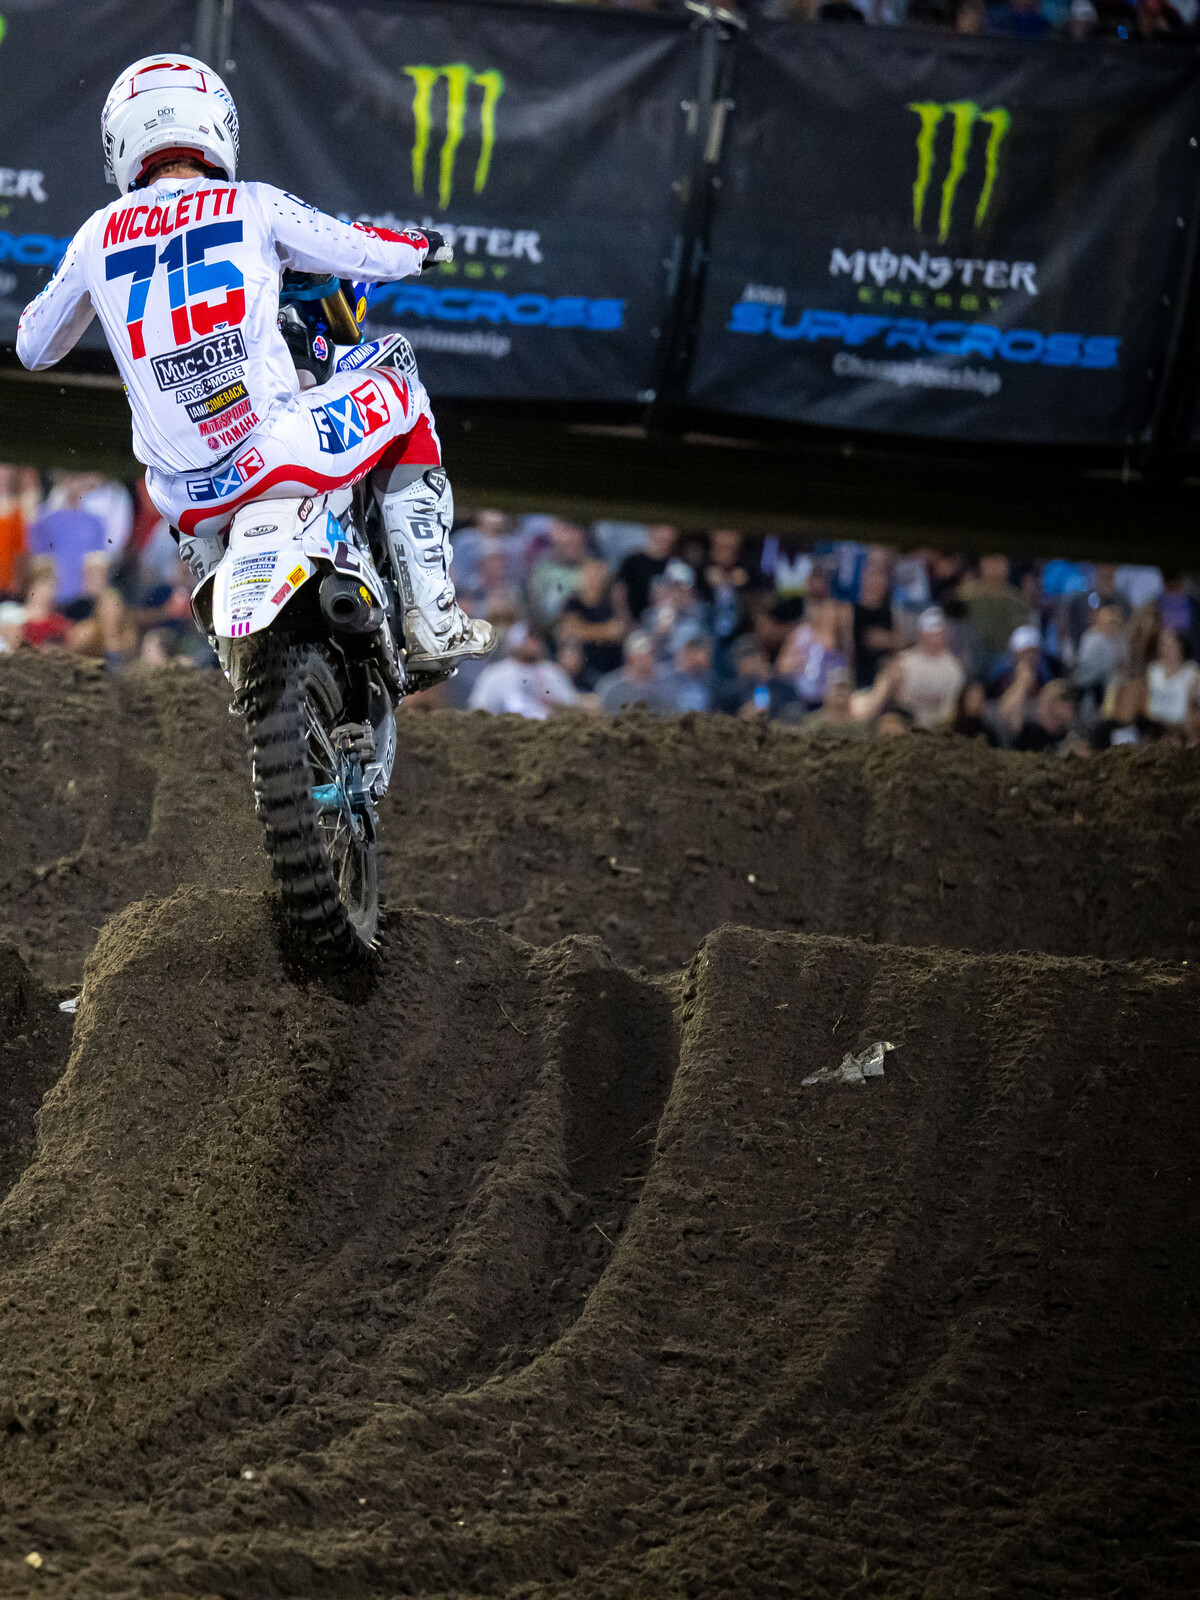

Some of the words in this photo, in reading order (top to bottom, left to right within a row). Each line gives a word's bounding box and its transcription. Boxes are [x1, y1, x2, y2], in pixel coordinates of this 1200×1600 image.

[157, 107, 176, 117] DOT
[103, 188, 237, 249] NICOLETTI
[105, 220, 246, 360] 715
[828, 246, 1038, 297] MONSTER
[159, 334, 241, 385] Muc-Off
[346, 343, 376, 369] YAMAHA
[219, 412, 260, 447] YAMAHA
[311, 379, 390, 454] FXR
[187, 447, 265, 501] FXR
